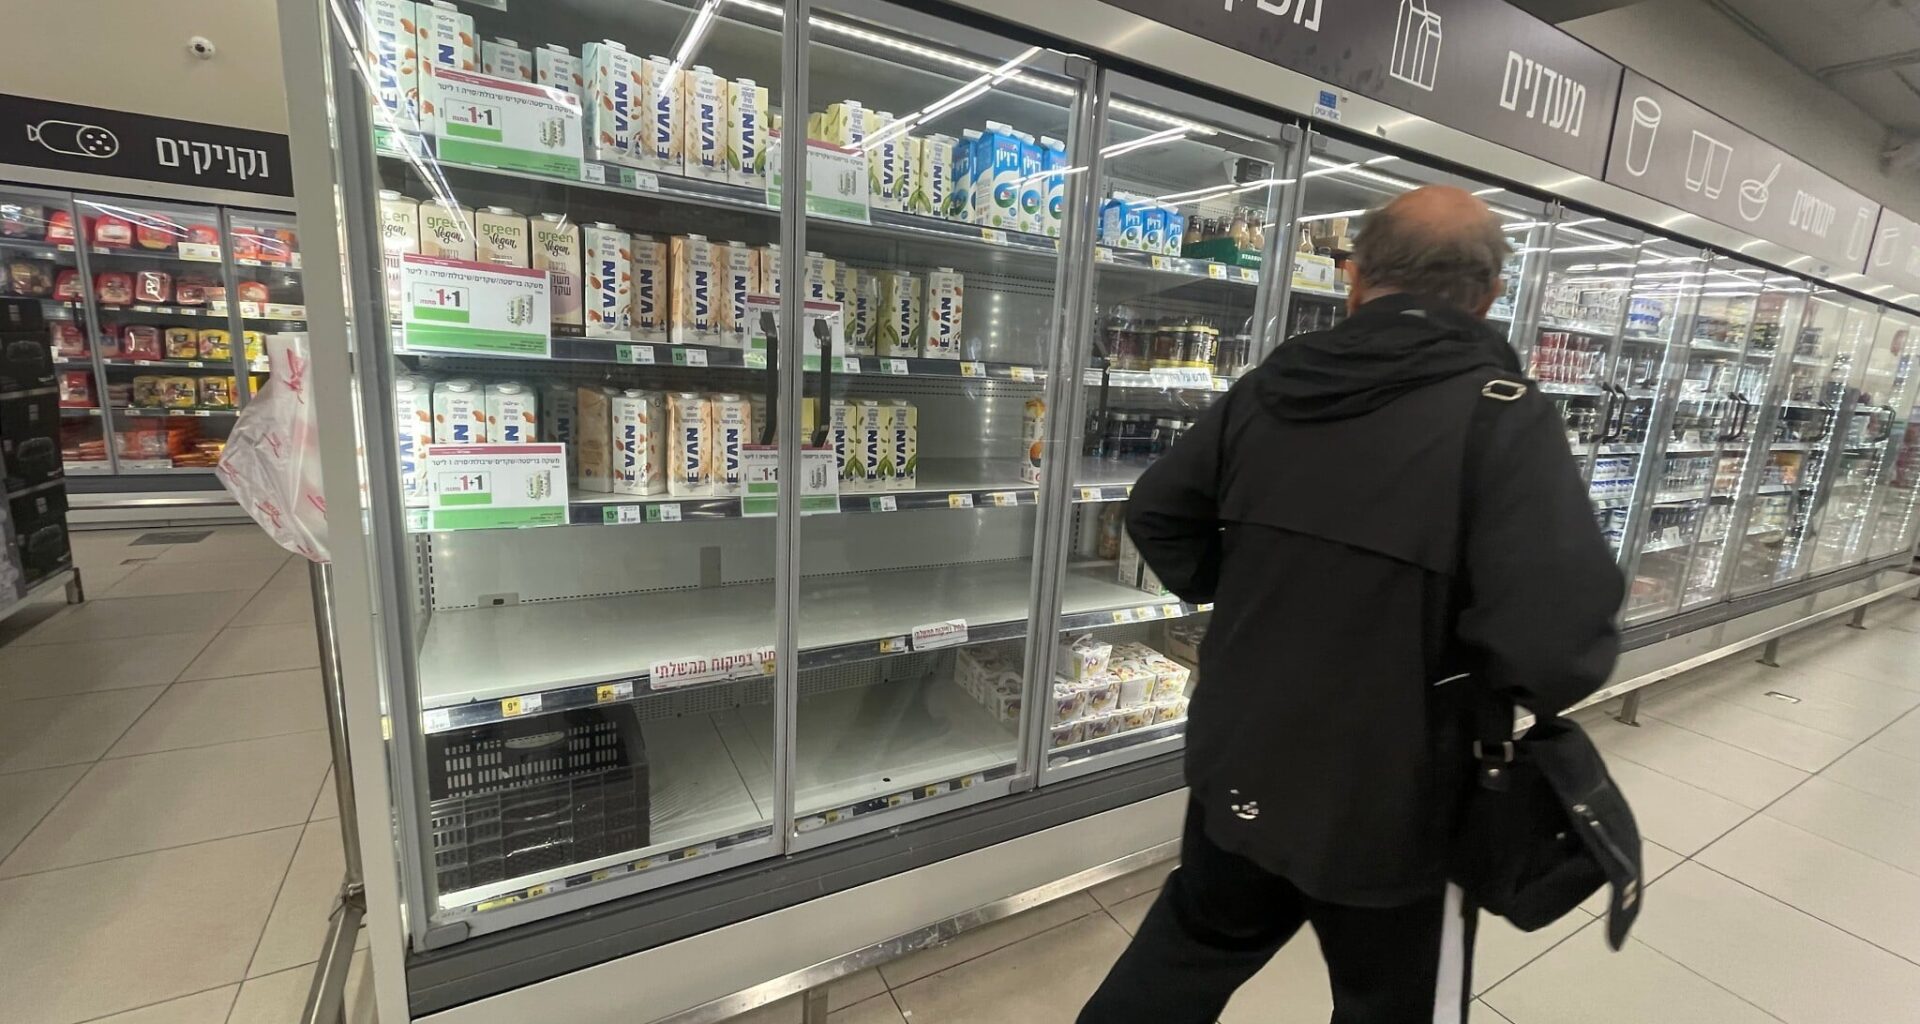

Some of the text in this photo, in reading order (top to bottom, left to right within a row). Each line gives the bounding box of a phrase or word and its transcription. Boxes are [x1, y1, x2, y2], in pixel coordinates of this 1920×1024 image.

[468, 106, 493, 126] 1+1
[615, 80, 628, 149] EVAN
[1500, 51, 1587, 138] מעדנים
[156, 136, 269, 180] נקניקים
[701, 104, 714, 167] EVAN
[742, 113, 754, 174] EVAN
[883, 143, 895, 199] EVAN
[933, 165, 942, 216] EVAN
[427, 216, 468, 231] green
[482, 223, 521, 236] green
[538, 231, 574, 243] green
[436, 288, 461, 307] 1+1
[602, 260, 616, 324] EVAN
[640, 269, 653, 328] EVAN
[695, 271, 708, 331] EVAN
[855, 298, 867, 346] EVAN
[901, 299, 910, 348] EVAN
[940, 297, 952, 348] EVAN
[624, 425, 636, 481] EVAN
[686, 428, 699, 483] EVAN
[726, 429, 739, 484] EVAN
[867, 430, 878, 479] EVAN
[896, 430, 906, 478] EVAN
[460, 475, 483, 491] 1+1
[655, 650, 776, 679] חיר בפיקוח ממשלתי
